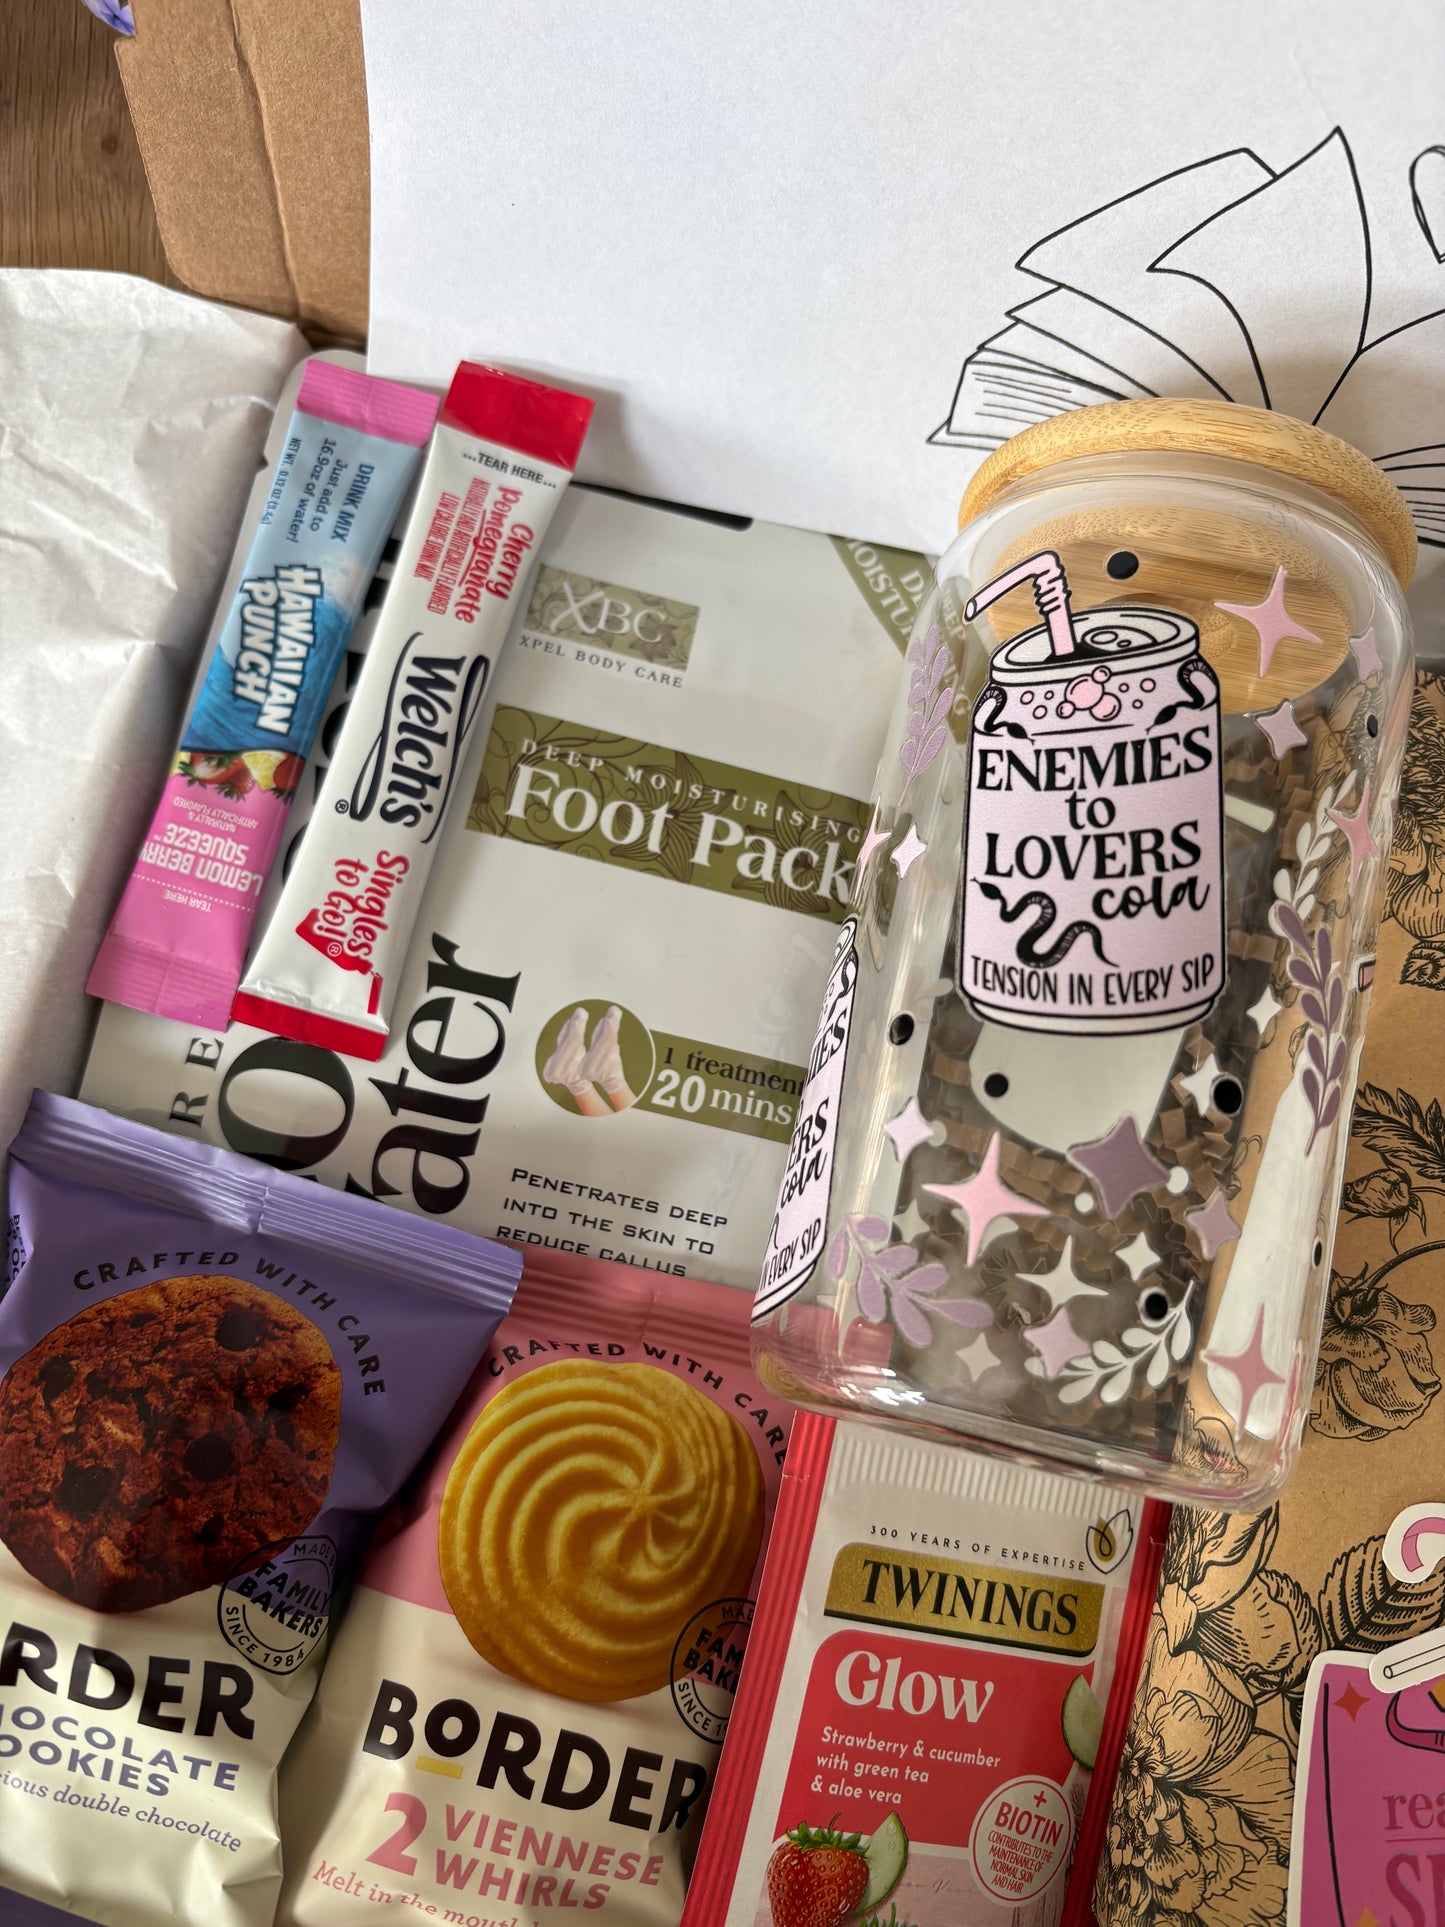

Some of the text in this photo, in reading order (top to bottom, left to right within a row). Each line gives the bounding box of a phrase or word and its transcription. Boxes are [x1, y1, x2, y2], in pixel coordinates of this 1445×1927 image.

[290, 438, 303, 457] NET
[286, 437, 337, 544] 16.9oz of water!
[309, 459, 348, 532] Just add to
[331, 463, 375, 543] DRINK MIX
[454, 486, 523, 625] Pomegranate
[485, 523, 535, 601] Cherry
[550, 580, 667, 644] XBC
[846, 537, 914, 638] OISTU
[231, 577, 280, 707] PUNCH
[255, 564, 324, 736] HAWAIIAN
[519, 635, 684, 689] XPEL BODY CARE
[379, 654, 468, 832] Welch's
[976, 725, 1214, 792] ENEMIES
[172, 797, 259, 830] ARTIFICIALLY FLAVORED
[520, 738, 861, 844] DEEP MOISTURISING
[1065, 790, 1116, 830] to
[187, 811, 236, 833] NATURALLY &
[504, 763, 858, 904] Foot Pack
[984, 820, 1202, 881] LOVERS
[139, 841, 198, 875] BERRY
[199, 855, 265, 897] LEMON
[335, 857, 369, 888] to
[164, 889, 212, 913] TEAR HERE
[347, 849, 410, 957] Singles
[1092, 876, 1211, 920] cola
[971, 952, 1215, 1006] TENSION IN EVERY SIP
[345, 931, 522, 1215] ater
[663, 1047, 674, 1065] 1
[650, 1068, 793, 1126] 20 mins
[780, 1147, 827, 1209] cola
[502, 1196, 715, 1256] INTO THE SKIN TO
[668, 1204, 728, 1228] DEEP
[496, 1225, 687, 1278] REDUCE CALLUS
[767, 1238, 799, 1286] EVERY
[799, 1217, 821, 1260] SIP
[73, 1250, 386, 1397] CRAFTED WITH CARE
[487, 1339, 788, 1467] CRAFTED WITH CARE
[870, 1524, 1086, 1571] 300 YEARS OF EXPERTISE
[236, 1576, 324, 1639] BAKERS
[254, 1560, 329, 1614] FAMILY
[721, 1605, 756, 1620] MAD
[863, 1558, 1079, 1636] TWININGS
[226, 1605, 305, 1667] SINCE 1984
[695, 1627, 745, 1669] FAM
[683, 1647, 739, 1695] BAK
[834, 1650, 995, 1724] Glow
[678, 1681, 712, 1732] SINCE
[0, 1703, 240, 1792] OCOLATE
[361, 1677, 708, 1834] BORDER
[815, 1750, 930, 1784] with green tea
[821, 1725, 1002, 1768] Strawberry & cucumber
[0, 1768, 242, 1853] ious double chocolate
[810, 1775, 902, 1804] & aloe vera
[365, 1791, 428, 1877] 2
[444, 1803, 665, 1887] VIENNESE
[987, 1830, 1054, 1863] CONTRIBUTES TO THE
[994, 1801, 1064, 1848] BIOTIN
[311, 1859, 365, 1898] Melt
[367, 1882, 394, 1904] in
[399, 1892, 437, 1916] the
[435, 1847, 611, 1910] WHIRLS
[988, 1844, 1044, 1873] MAINTENANCE OF
[990, 1858, 1035, 1884] NORMAL SKIN
[991, 1873, 1008, 1889] AND
[1006, 1878, 1024, 1894] HAIR
